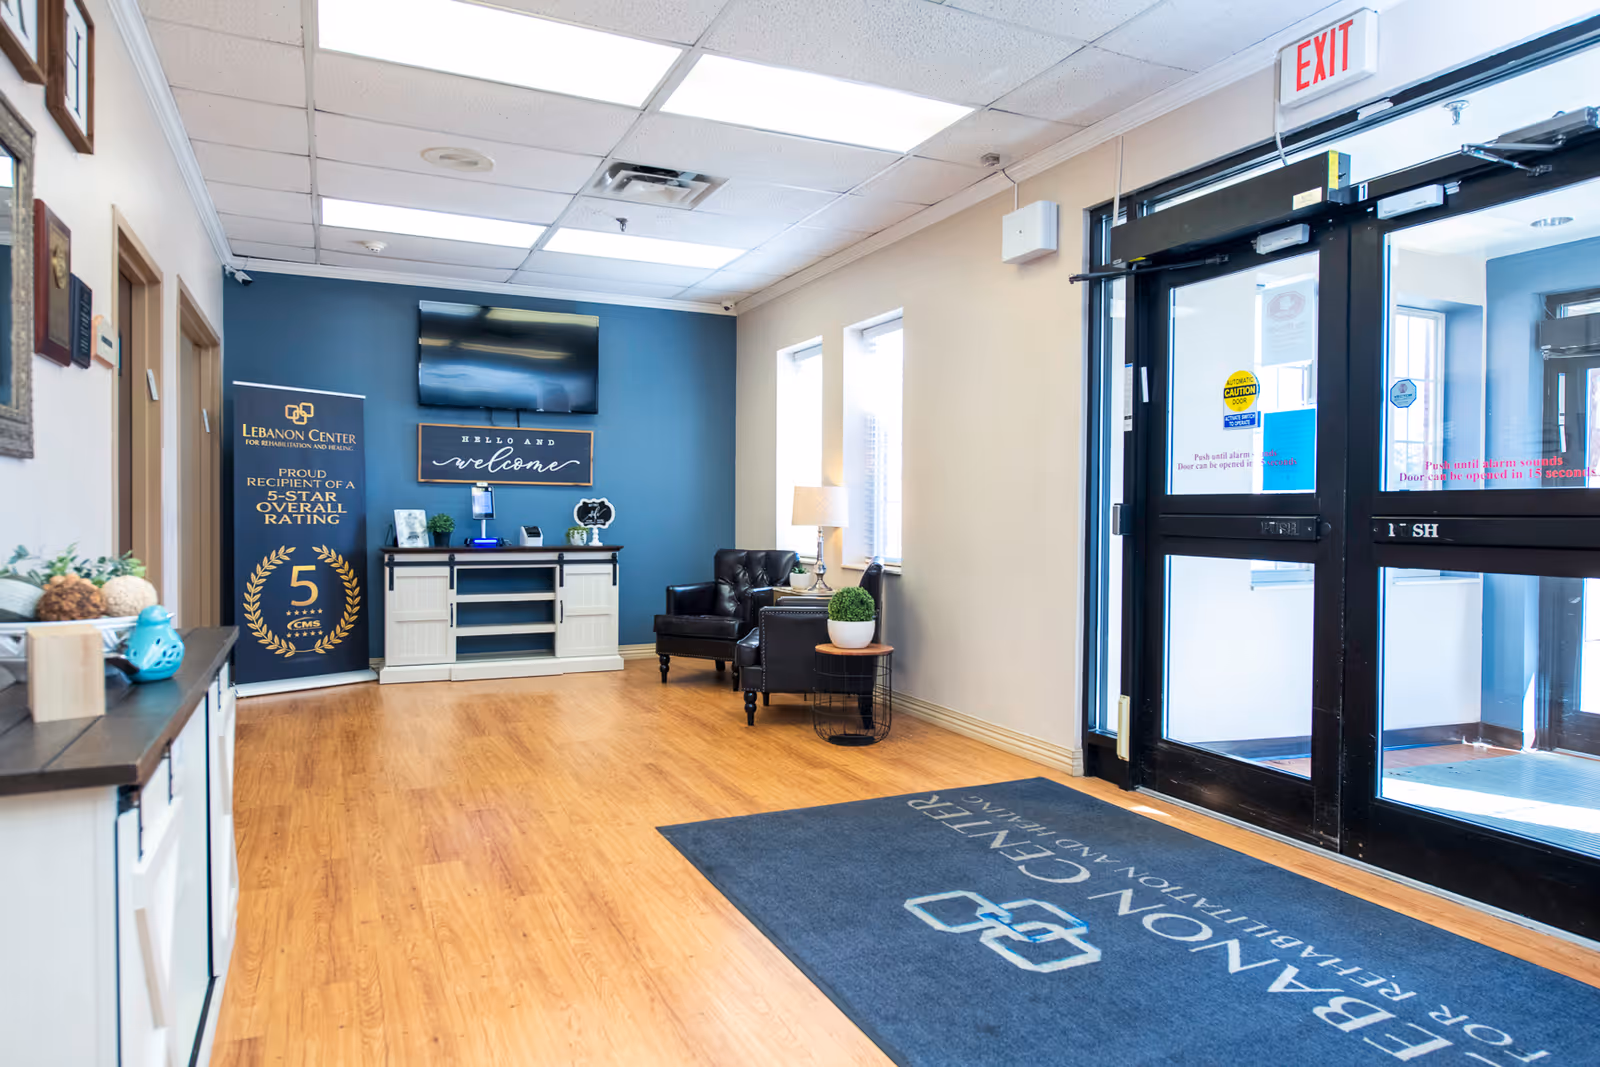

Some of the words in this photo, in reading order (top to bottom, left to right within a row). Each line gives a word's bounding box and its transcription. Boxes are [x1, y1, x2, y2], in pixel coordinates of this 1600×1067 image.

[1296, 19, 1353, 92] EXIT
[1226, 376, 1254, 386] AUTOMATIC
[1224, 385, 1256, 398] CAUTION
[1232, 397, 1248, 405] DOOR
[243, 423, 304, 441] LEBANON
[309, 429, 357, 445] CENTER
[261, 440, 312, 449] REHABILITATION
[461, 435, 514, 445] HELLO
[524, 437, 556, 446] AND
[432, 446, 581, 473] welcome
[1194, 453, 1210, 461] Push
[1212, 452, 1228, 460] until
[1229, 451, 1250, 459] alarm
[1195, 461, 1208, 469] can
[1209, 460, 1218, 468] be
[1219, 460, 1245, 470] opened
[1425, 461, 1451, 470] Push
[1454, 459, 1479, 469] until
[1482, 459, 1516, 468] alarm
[1520, 456, 1563, 467] sounds
[279, 468, 327, 479] PROUD
[1399, 472, 1425, 482] Door
[1427, 473, 1446, 481] can
[1450, 471, 1463, 480] be
[1466, 469, 1507, 482] opened
[1511, 468, 1523, 478] in
[1529, 468, 1542, 478] 15
[247, 477, 322, 488] RECIPIENT
[325, 480, 343, 489] OF
[345, 481, 355, 489] A
[267, 490, 337, 502] 5-STAR
[256, 502, 348, 514] OVERALL
[264, 514, 340, 525] RATING
[290, 565, 319, 607] 5
[293, 619, 321, 629] CMS
[960, 795, 1057, 837] HEALING
[906, 794, 1091, 884] CENTER
[1055, 838, 1121, 863] AND
[1113, 866, 1418, 1001] REHABILITATION
[1428, 1004, 1550, 1063] FOR
